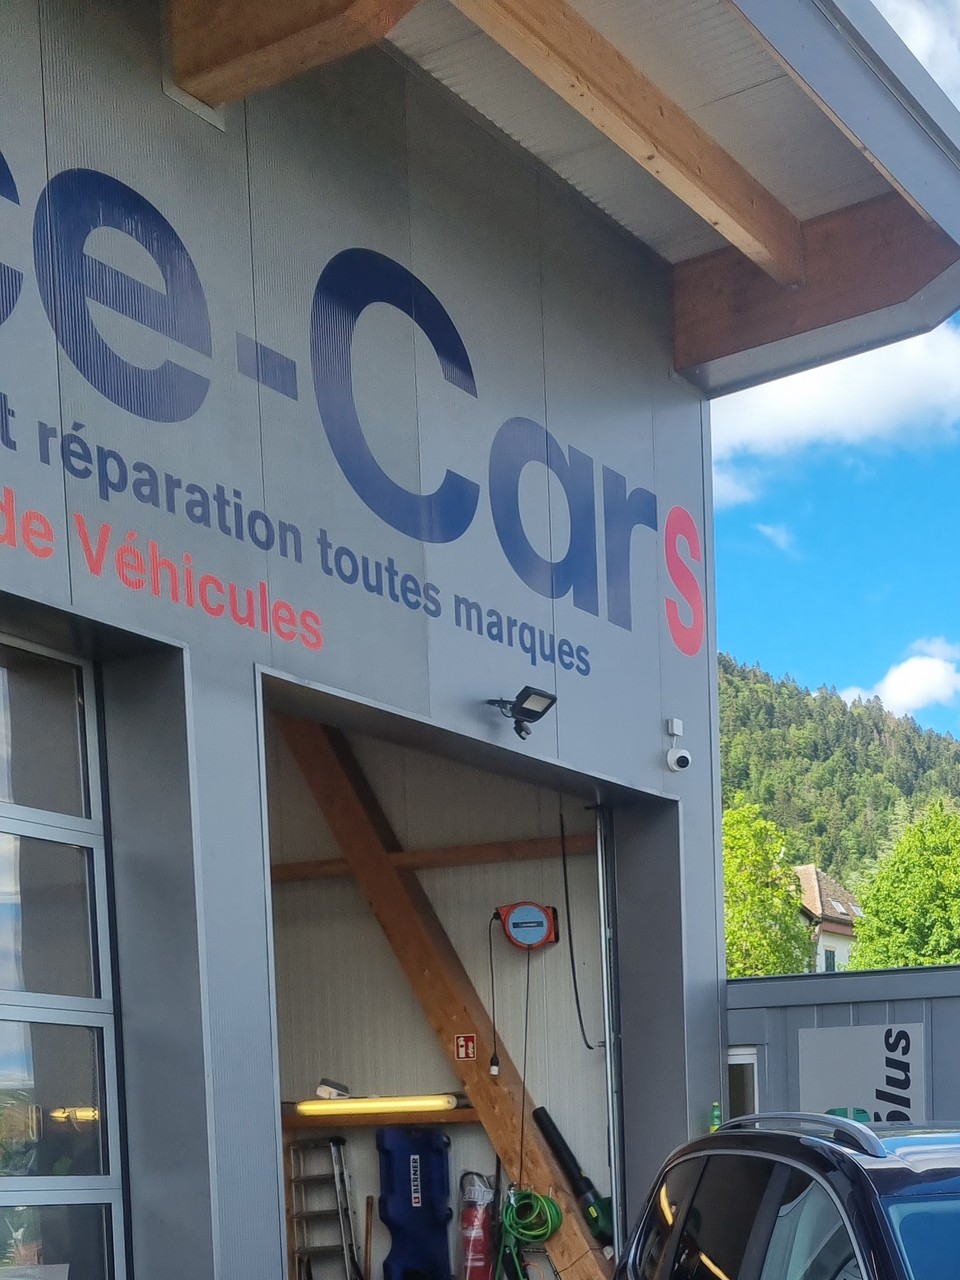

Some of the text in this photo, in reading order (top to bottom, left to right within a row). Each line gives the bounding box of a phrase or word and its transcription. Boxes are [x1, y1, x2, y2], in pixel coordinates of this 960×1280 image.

[0, 153, 704, 657] e-Cars
[37, 420, 303, 564] réparation
[316, 527, 442, 618] toutes
[454, 593, 592, 677] marques
[73, 511, 324, 651] Véhicules
[412, 1157, 420, 1194] BERNER
